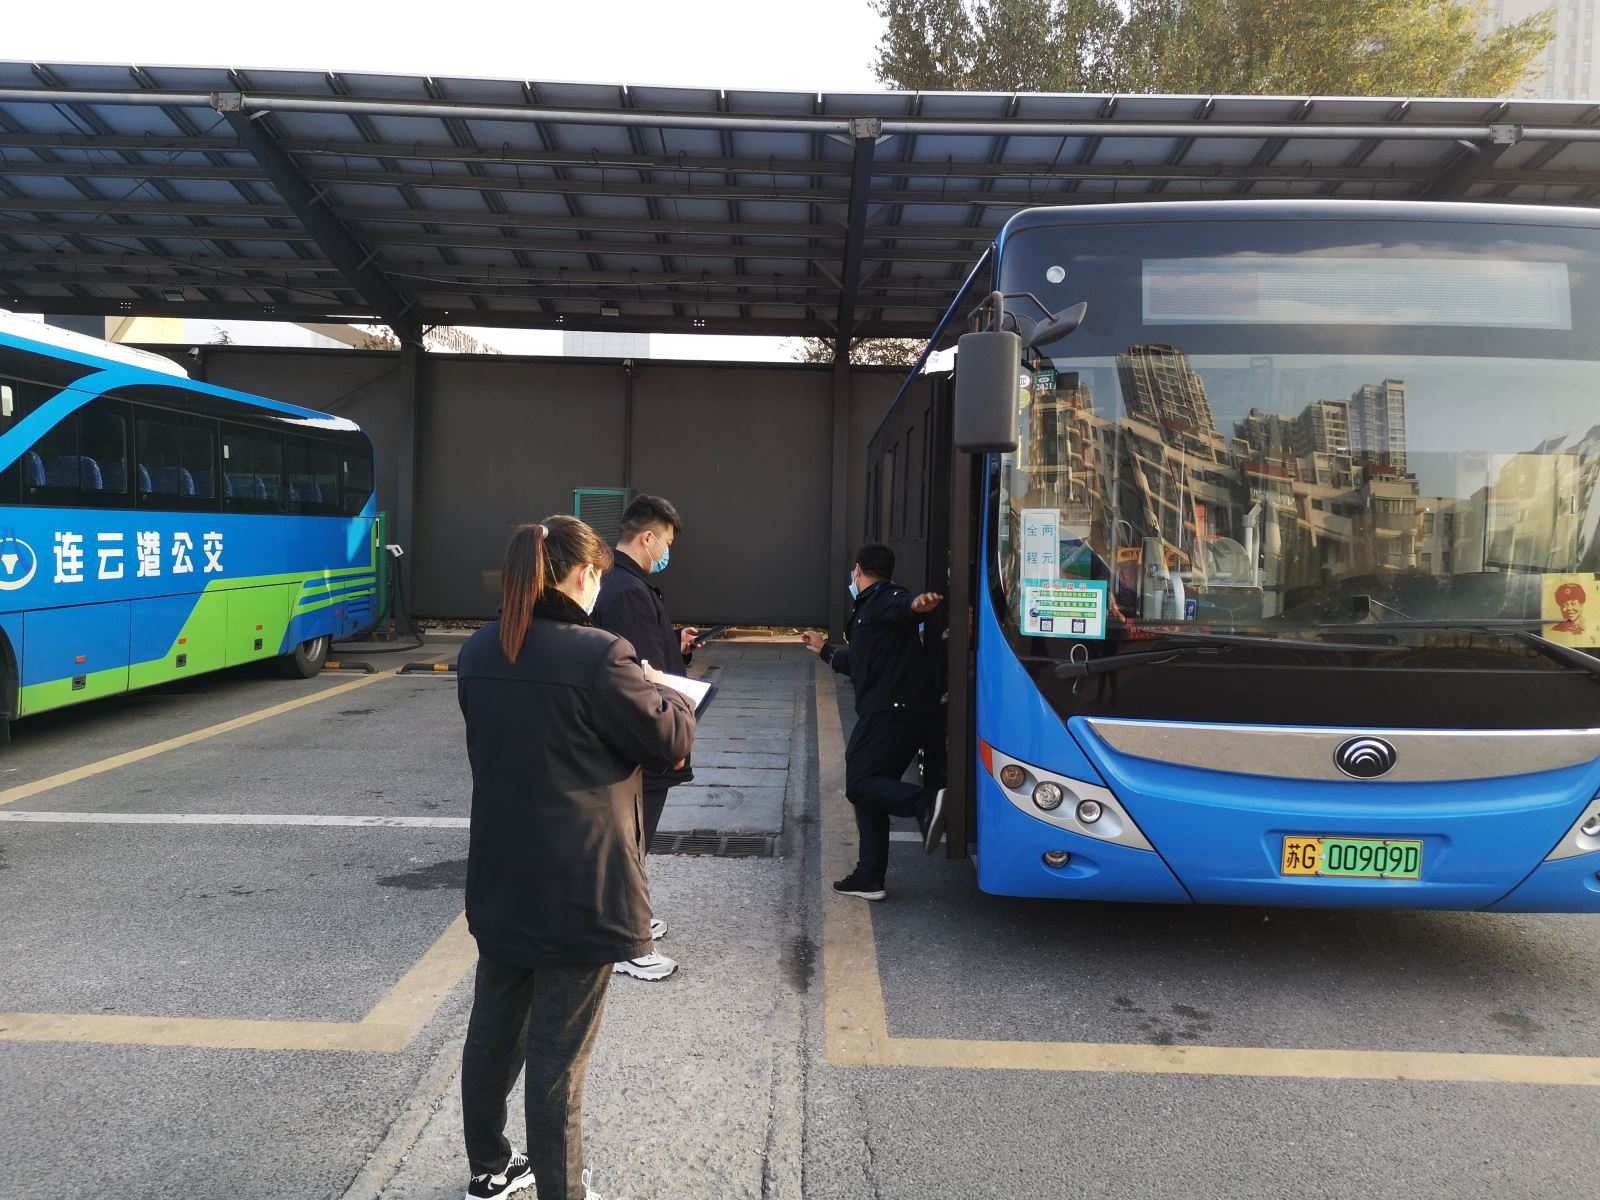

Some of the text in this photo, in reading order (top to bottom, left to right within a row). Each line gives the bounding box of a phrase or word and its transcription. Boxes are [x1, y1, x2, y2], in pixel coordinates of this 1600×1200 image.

[53, 531, 224, 584] 连云港公交
